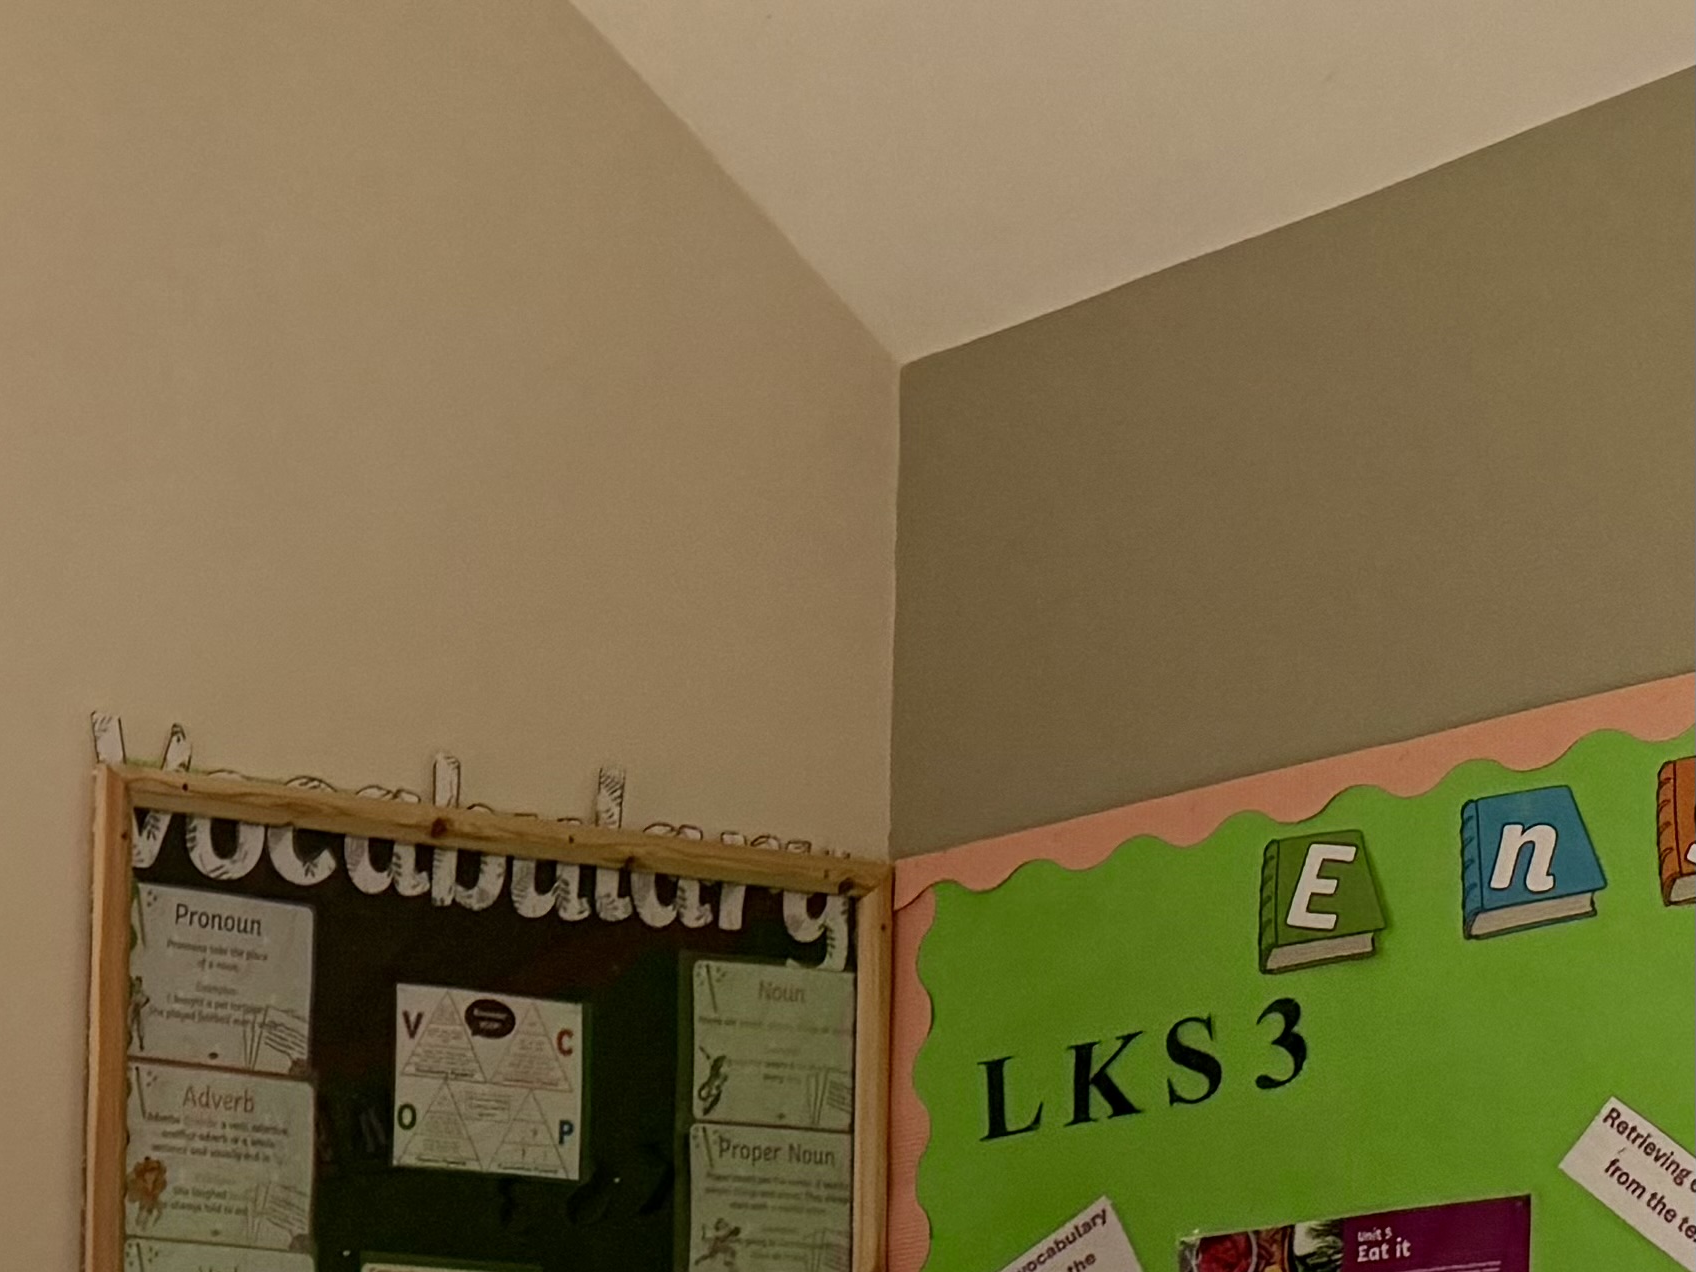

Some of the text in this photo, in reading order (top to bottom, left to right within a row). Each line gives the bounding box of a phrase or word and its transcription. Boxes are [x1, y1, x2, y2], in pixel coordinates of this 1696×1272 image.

[175, 903, 262, 936] Pronoun
[759, 980, 805, 1002] Noun
[403, 1010, 423, 1038] V
[557, 1029, 573, 1056] C
[977, 997, 1308, 1141] LKS3
[183, 1085, 254, 1113] Adverb
[397, 1103, 416, 1130] O
[559, 1120, 573, 1145] P
[1603, 1107, 1692, 1186] Retrieving
[719, 1135, 835, 1167] Proper Noun
[1604, 1158, 1677, 1223] from the
[1357, 1237, 1411, 1262] Eat it
